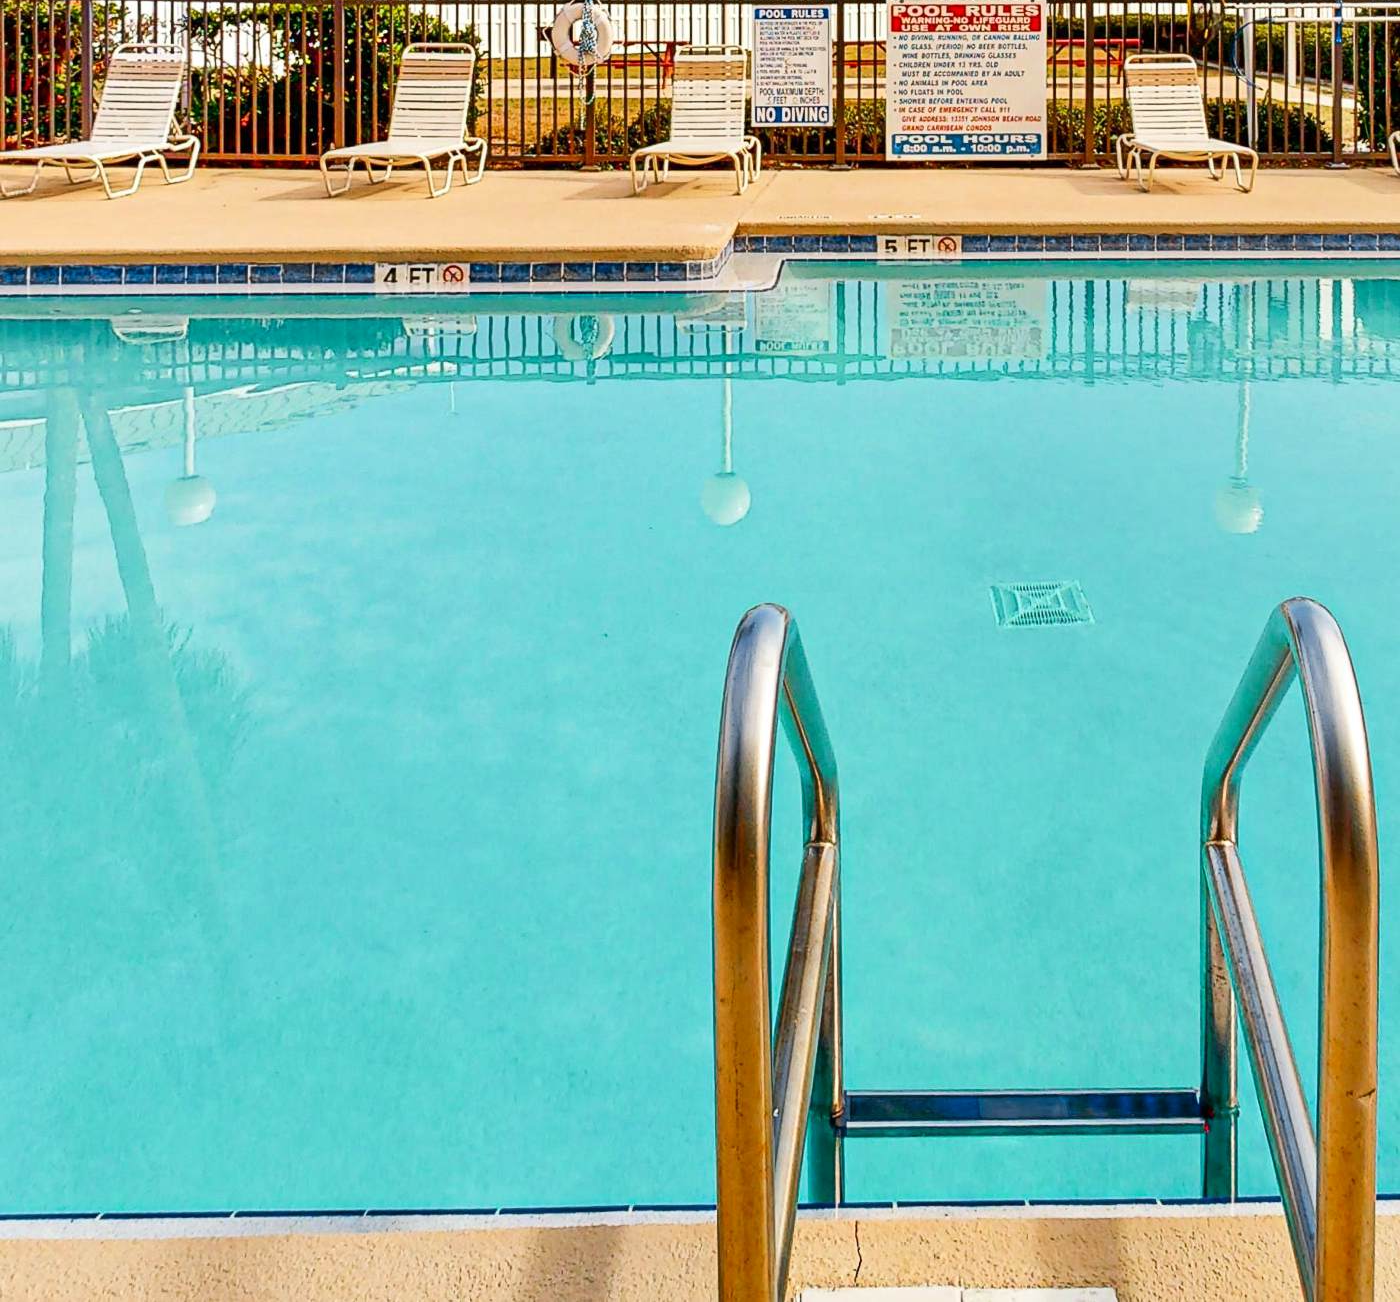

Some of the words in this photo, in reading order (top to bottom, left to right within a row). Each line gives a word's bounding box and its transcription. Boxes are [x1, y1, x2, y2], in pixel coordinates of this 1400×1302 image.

[759, 9, 787, 18] POOL
[791, 9, 825, 18] RULES
[893, 5, 954, 17] POOL
[965, 5, 1039, 17] RULES
[901, 16, 969, 24] WARNING-NO
[973, 16, 1031, 24] LIFEGUARD
[901, 24, 929, 32] USE
[935, 24, 953, 32] AT
[958, 24, 991, 32] OWN
[998, 24, 1031, 32] RISK
[936, 43, 964, 51] (PERIOD)
[759, 87, 775, 95] POOL
[776, 87, 803, 95] MAXIMUM
[773, 96, 787, 105] FEET
[799, 96, 820, 105] INCHES
[756, 107, 776, 122] NO
[781, 107, 828, 122] DIVING
[894, 134, 953, 144] POOL
[962, 134, 1039, 144] HOURS
[902, 144, 928, 153] 8:00
[932, 145, 957, 153] a.m.
[970, 144, 1001, 153] 10:00
[1006, 144, 1030, 154] p.m.
[884, 239, 898, 254] 5
[907, 239, 931, 254] FT
[383, 267, 398, 283] 4
[409, 267, 435, 284] FT
